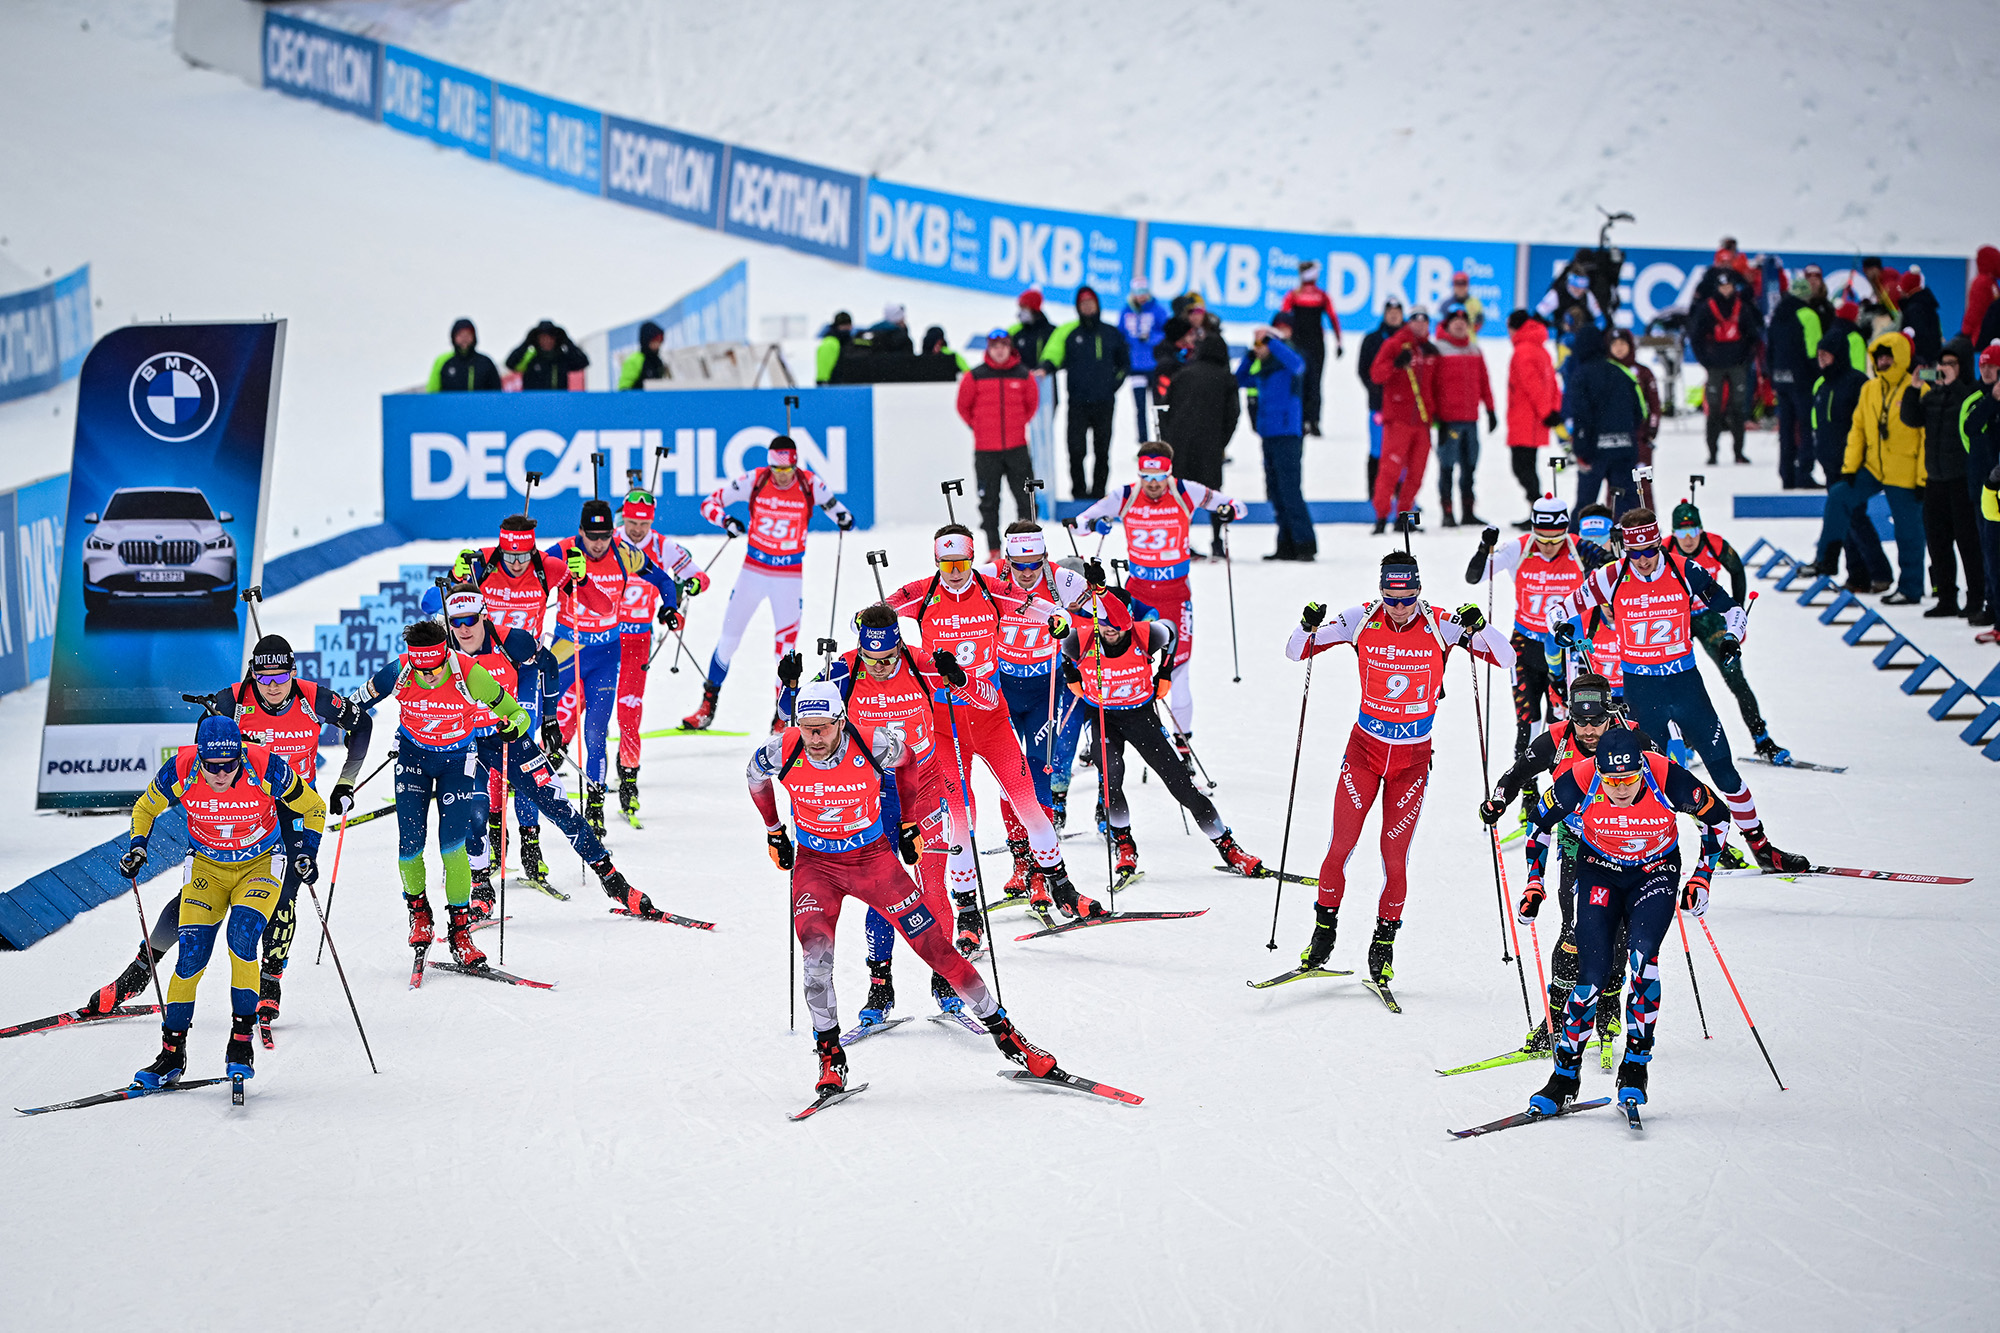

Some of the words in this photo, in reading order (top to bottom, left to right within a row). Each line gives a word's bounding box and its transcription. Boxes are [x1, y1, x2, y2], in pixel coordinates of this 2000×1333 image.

[608, 127, 714, 215] DECATHLON
[731, 149, 851, 249] DECATHLON
[868, 193, 950, 269] DKB
[989, 215, 1084, 288] DKB
[1151, 237, 1261, 308] DKB
[1327, 251, 1454, 318] DKB
[410, 427, 847, 500] DECATHLON
[755, 497, 805, 509] VIESSMANN
[1128, 506, 1178, 519] VIESSMANN
[757, 517, 790, 539] 25
[790, 527, 796, 539] 1
[1126, 518, 1179, 526] Wärmepumpen
[500, 532, 532, 542] VIESSMANN
[1131, 529, 1168, 549] 23
[1169, 538, 1176, 548] 1
[1154, 567, 1175, 581] iX1
[1521, 571, 1577, 584] VIESSMANN
[485, 587, 542, 600] VIESSMANN
[1545, 584, 1570, 592] pumps
[485, 598, 540, 607] Wärmepumpen
[1620, 593, 1683, 608] VIESSMANN
[490, 611, 528, 629] 13
[1627, 609, 1647, 618] Heat
[1648, 608, 1678, 617] pumps
[931, 614, 994, 630] VIESSMANN
[589, 631, 610, 644] iX1
[939, 630, 959, 638] Heat
[960, 629, 988, 638] pumps
[1001, 626, 1040, 648] 11
[1043, 634, 1050, 645] 1
[1630, 619, 1673, 645] 12
[1673, 627, 1681, 641] 1
[320, 634, 342, 651] 16
[350, 633, 375, 651] 17
[955, 641, 977, 667] 8
[983, 646, 990, 661] 1
[1366, 645, 1433, 660] VIESSMANN
[1624, 649, 1661, 657] POKLJUKA
[327, 660, 350, 677] 14
[360, 658, 384, 676] 15
[1025, 663, 1049, 677] iX1
[1367, 658, 1430, 672] Wärmepumpen
[1660, 659, 1684, 675] iX1
[1085, 666, 1145, 680] VISSMANN
[1112, 677, 1140, 685] pumps
[1384, 674, 1410, 699] 9
[1416, 684, 1425, 699] 1
[400, 700, 464, 711] VIESSMANN
[799, 700, 828, 708] pure
[857, 692, 923, 708] VIESSMANN
[1364, 699, 1400, 714] POKLJUKA
[858, 706, 922, 718] Wärmepumpen
[420, 719, 443, 733] 7
[886, 720, 907, 743] 5
[915, 724, 923, 739] 1
[1394, 722, 1418, 738] iX1
[274, 745, 306, 753] pumps
[953, 737, 965, 781] SALOMON
[1608, 752, 1631, 765] ice
[47, 756, 147, 776] POKLJUKA
[406, 766, 422, 775] NLB
[789, 783, 867, 797] VIESSMANN
[186, 799, 259, 813] VIESSMANN
[798, 796, 822, 805] Heat
[824, 797, 860, 806] pumps
[187, 810, 260, 821] Wärmepumpen
[1386, 795, 1425, 840] RAIFFEISEN
[1593, 815, 1669, 828] VIESSMANN
[214, 824, 235, 838] 1
[1594, 826, 1671, 836] Wärmepumpen
[837, 834, 865, 851] iX1
[1595, 859, 1623, 872] LAPUA
[1896, 873, 1940, 883] MADSHUS
[1634, 887, 1666, 907] CRAFT
